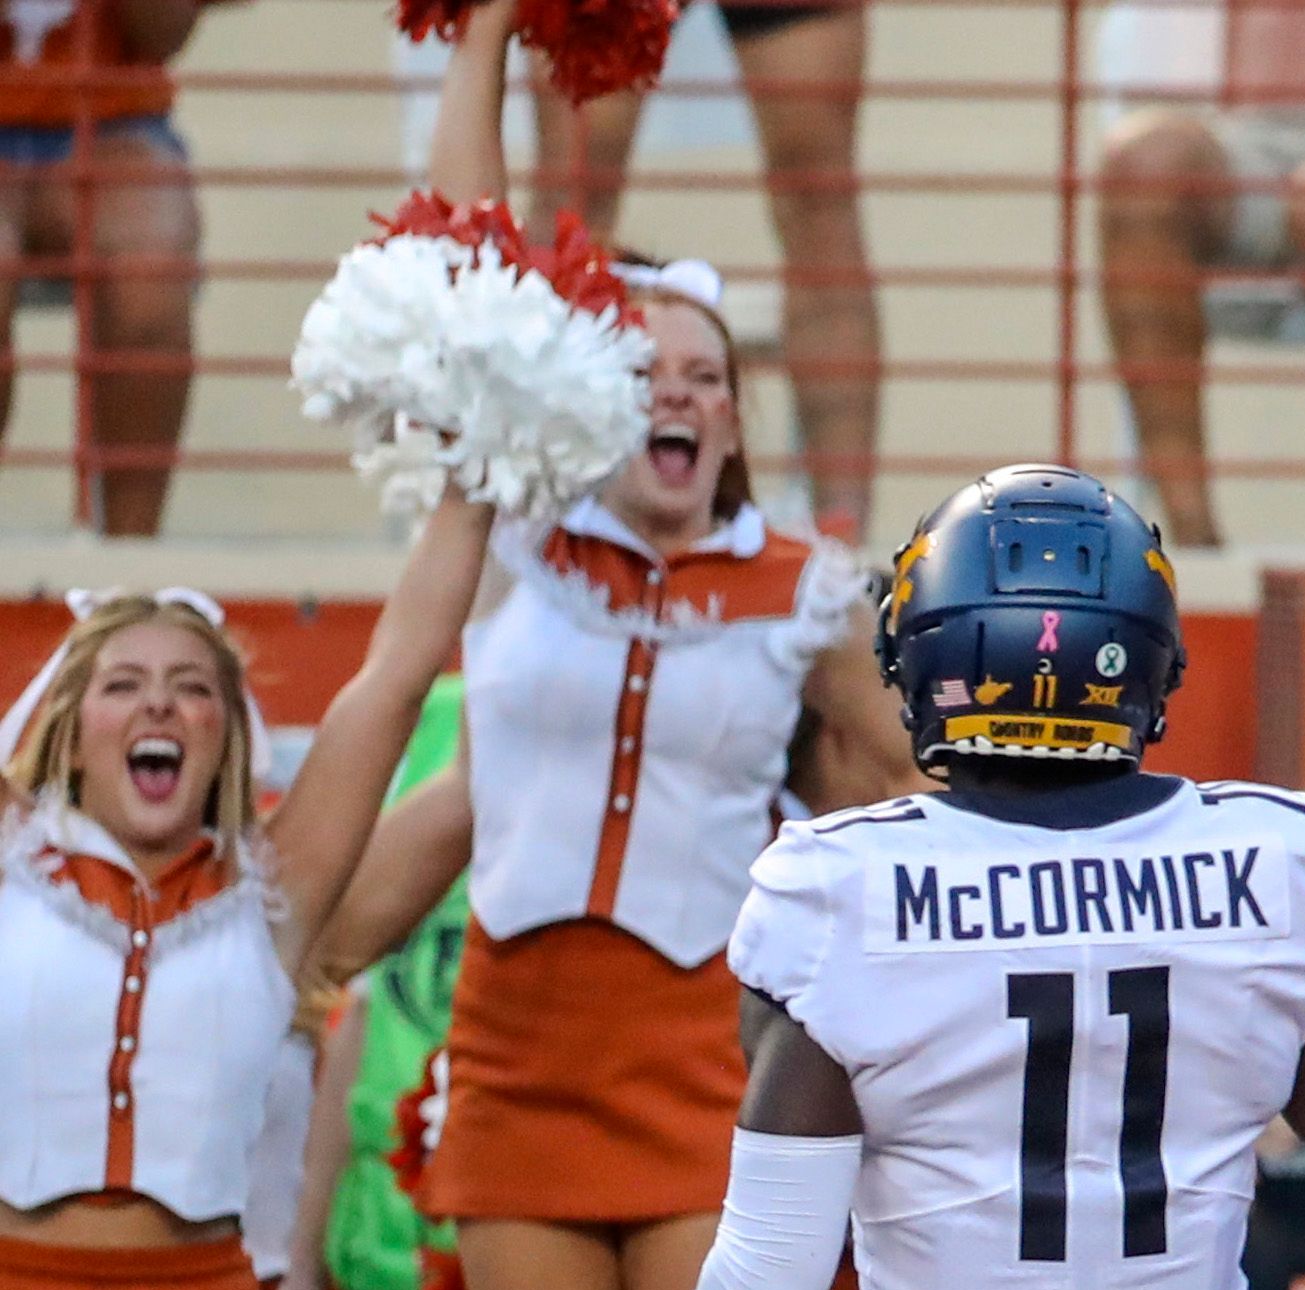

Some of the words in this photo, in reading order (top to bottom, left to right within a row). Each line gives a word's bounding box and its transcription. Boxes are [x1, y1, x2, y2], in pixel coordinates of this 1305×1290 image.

[1032, 674, 1057, 708] 11
[893, 846, 1268, 942] McCORMICK
[1006, 965, 1171, 1262] 11
